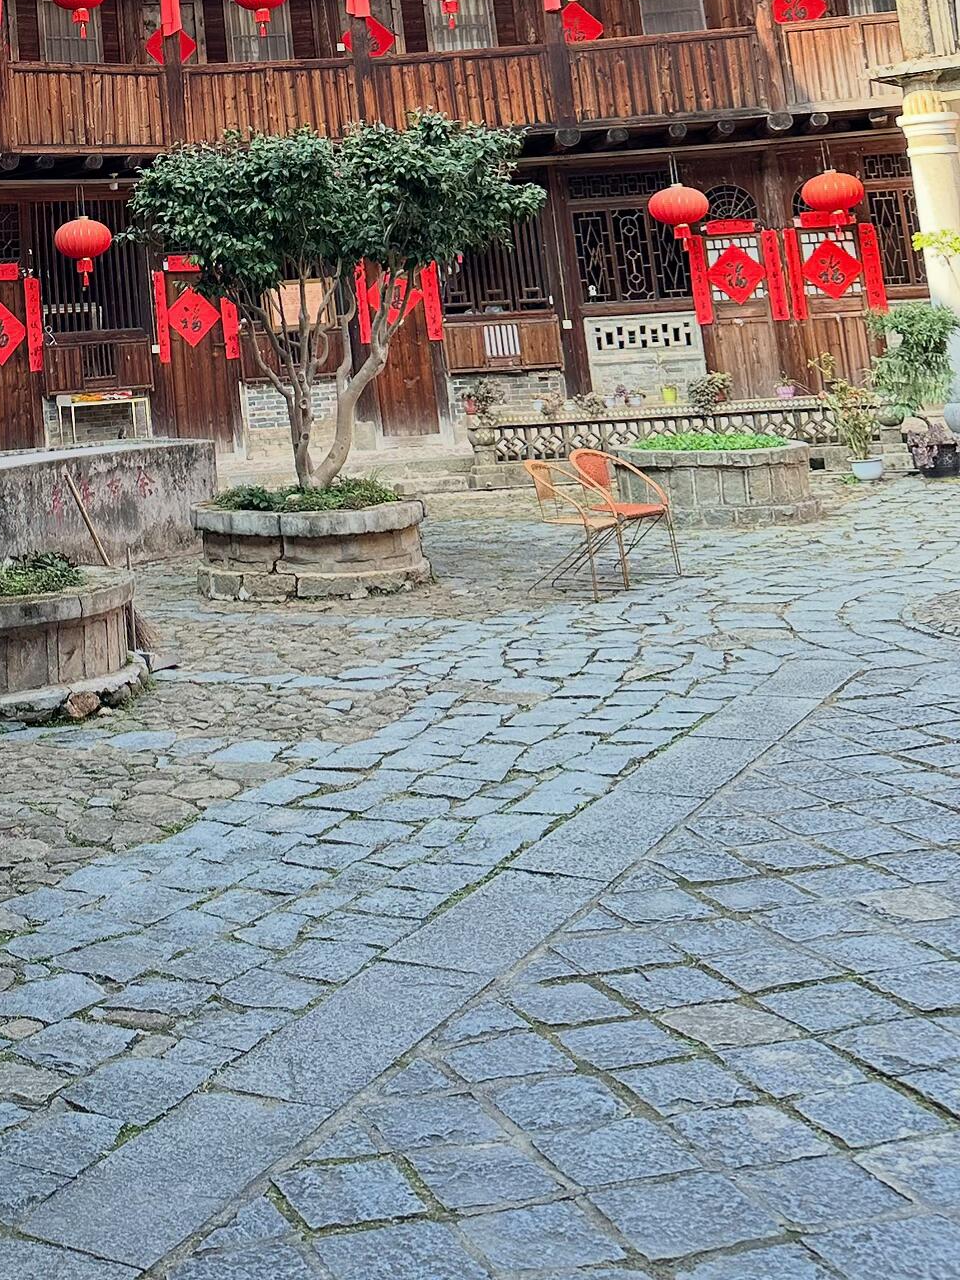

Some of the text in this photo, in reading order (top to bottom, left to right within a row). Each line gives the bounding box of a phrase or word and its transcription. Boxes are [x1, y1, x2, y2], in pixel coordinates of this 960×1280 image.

[724, 262, 748, 289] 福
[817, 254, 846, 285] 福
[180, 303, 202, 333] 福
